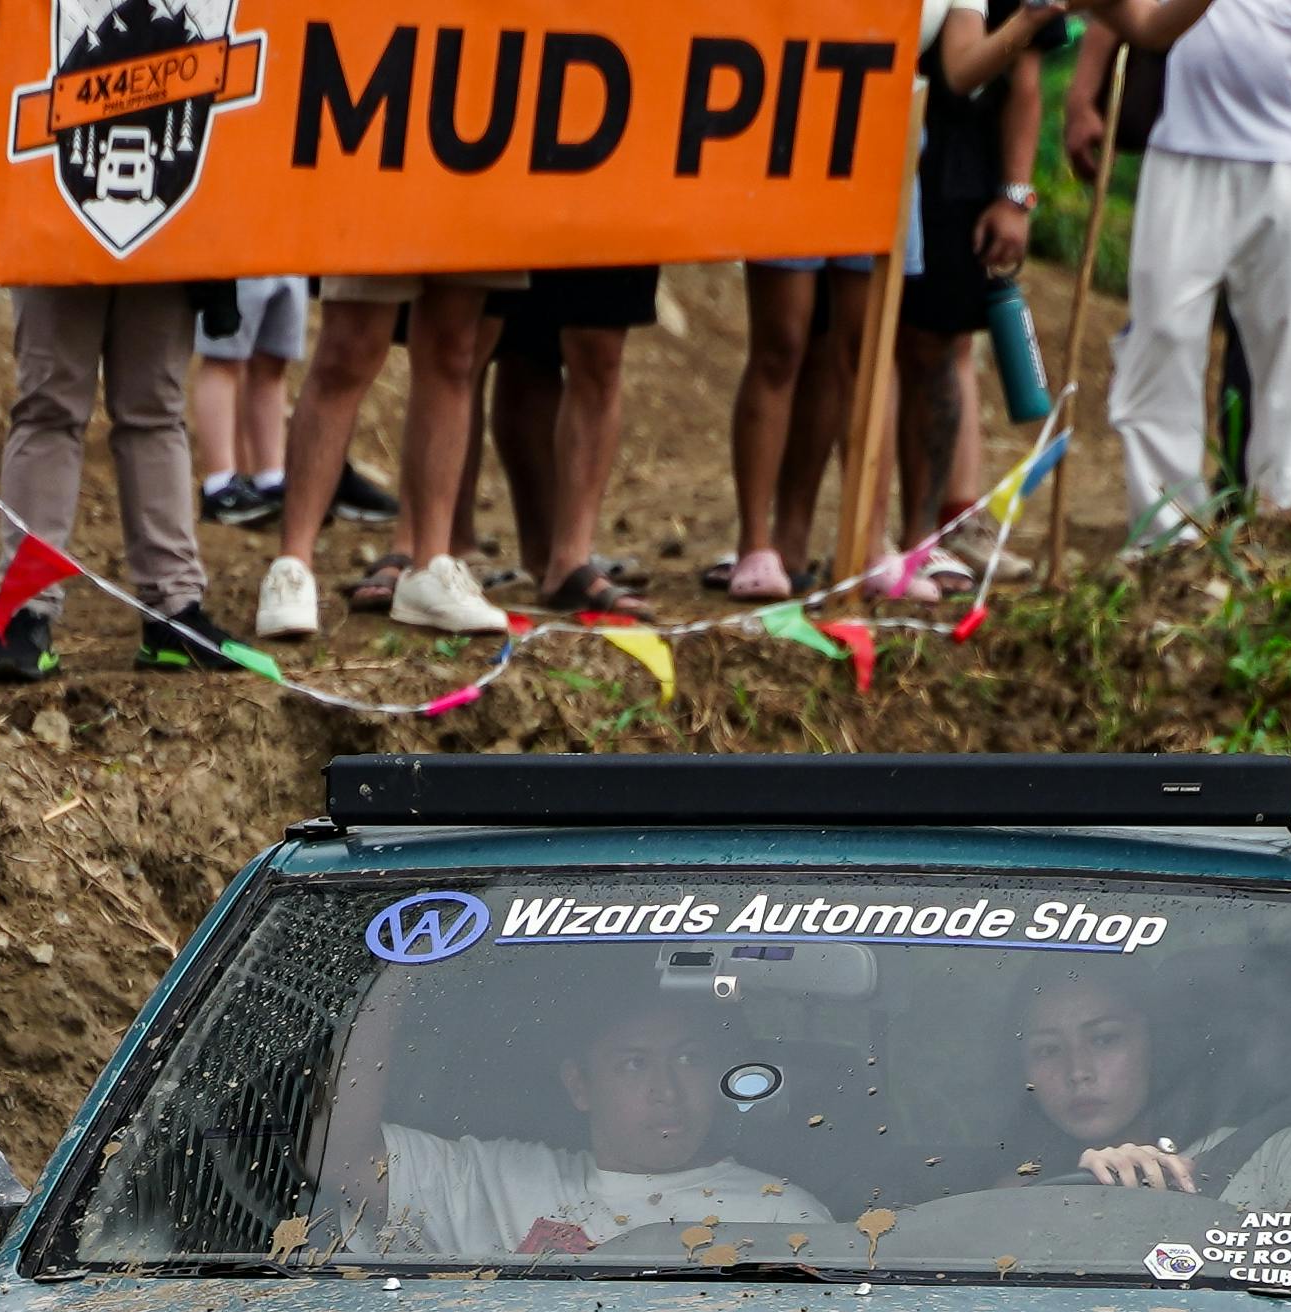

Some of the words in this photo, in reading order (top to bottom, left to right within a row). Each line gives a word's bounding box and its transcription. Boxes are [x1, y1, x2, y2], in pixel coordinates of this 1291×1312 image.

[291, 20, 632, 176] MUD
[674, 36, 897, 180] PIT
[500, 895, 720, 937] Wizards
[726, 894, 1016, 938] Automode
[1024, 901, 1168, 953] Shop
[1202, 1247, 1248, 1264] OFF
[1205, 1229, 1250, 1247] OFF
